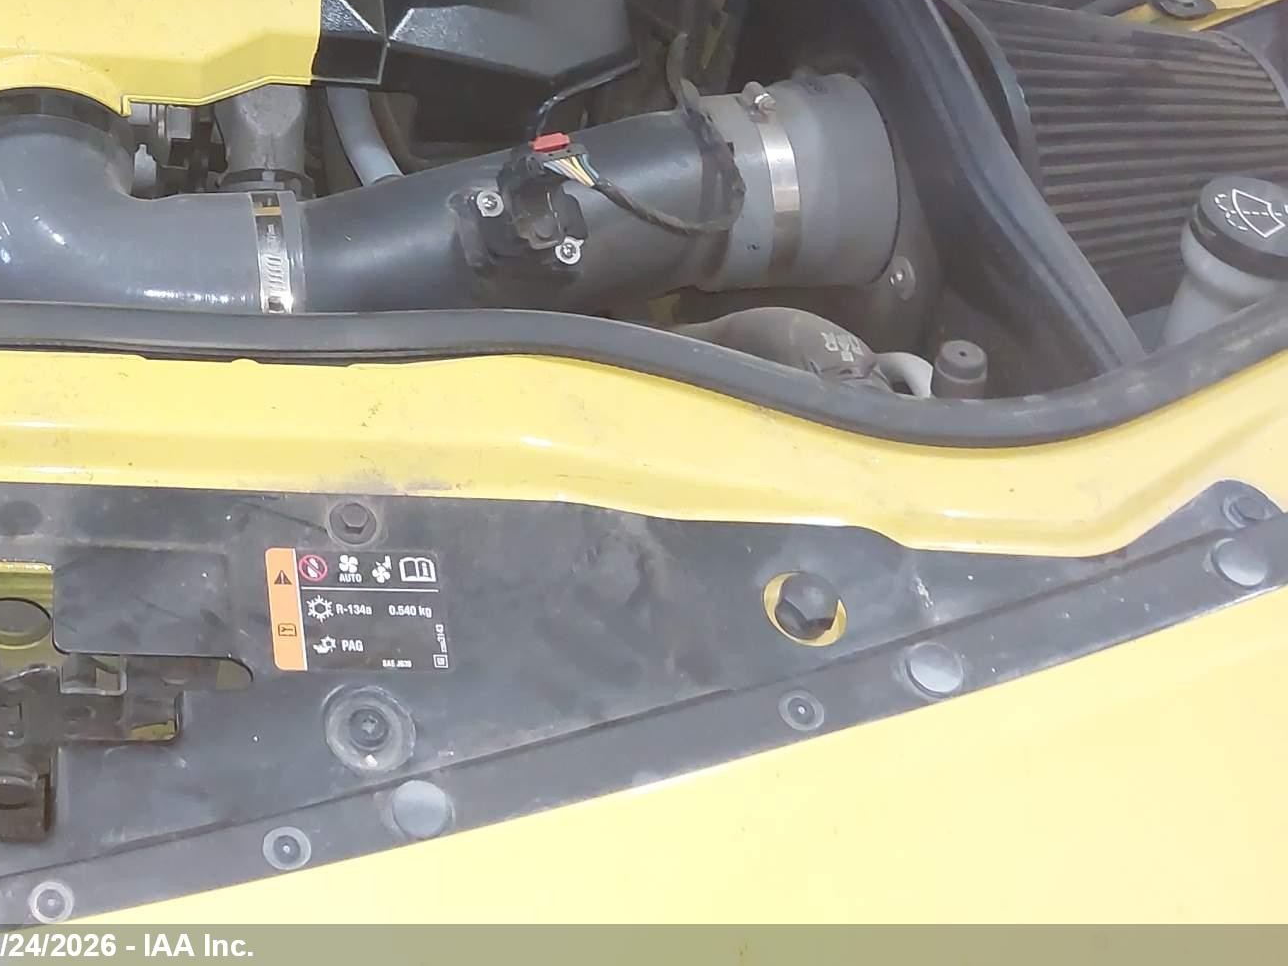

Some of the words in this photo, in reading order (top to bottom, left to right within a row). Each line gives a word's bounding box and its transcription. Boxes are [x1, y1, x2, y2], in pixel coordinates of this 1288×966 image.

[339, 573, 362, 583] AUTO
[335, 603, 373, 615] R-134a
[418, 607, 433, 618] kg
[341, 639, 364, 652] PAG
